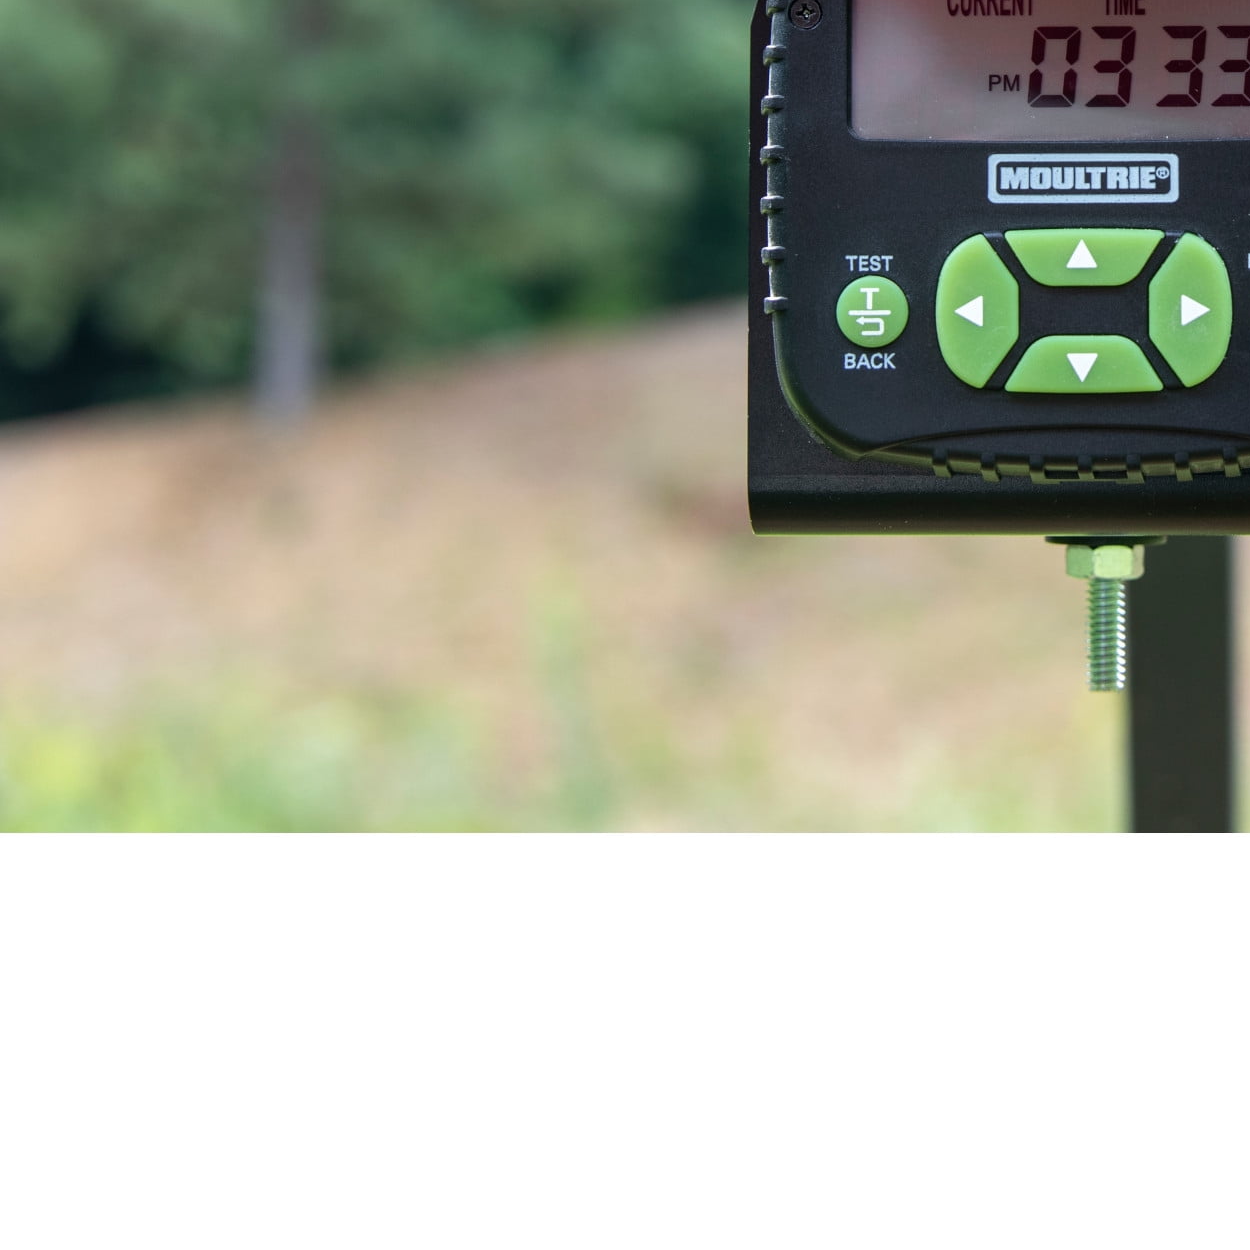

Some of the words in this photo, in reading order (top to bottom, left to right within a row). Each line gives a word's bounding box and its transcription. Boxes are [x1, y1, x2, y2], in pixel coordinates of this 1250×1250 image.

[988, 74, 1020, 92] PM
[845, 254, 893, 272] TEST
[843, 353, 896, 370] BACK
